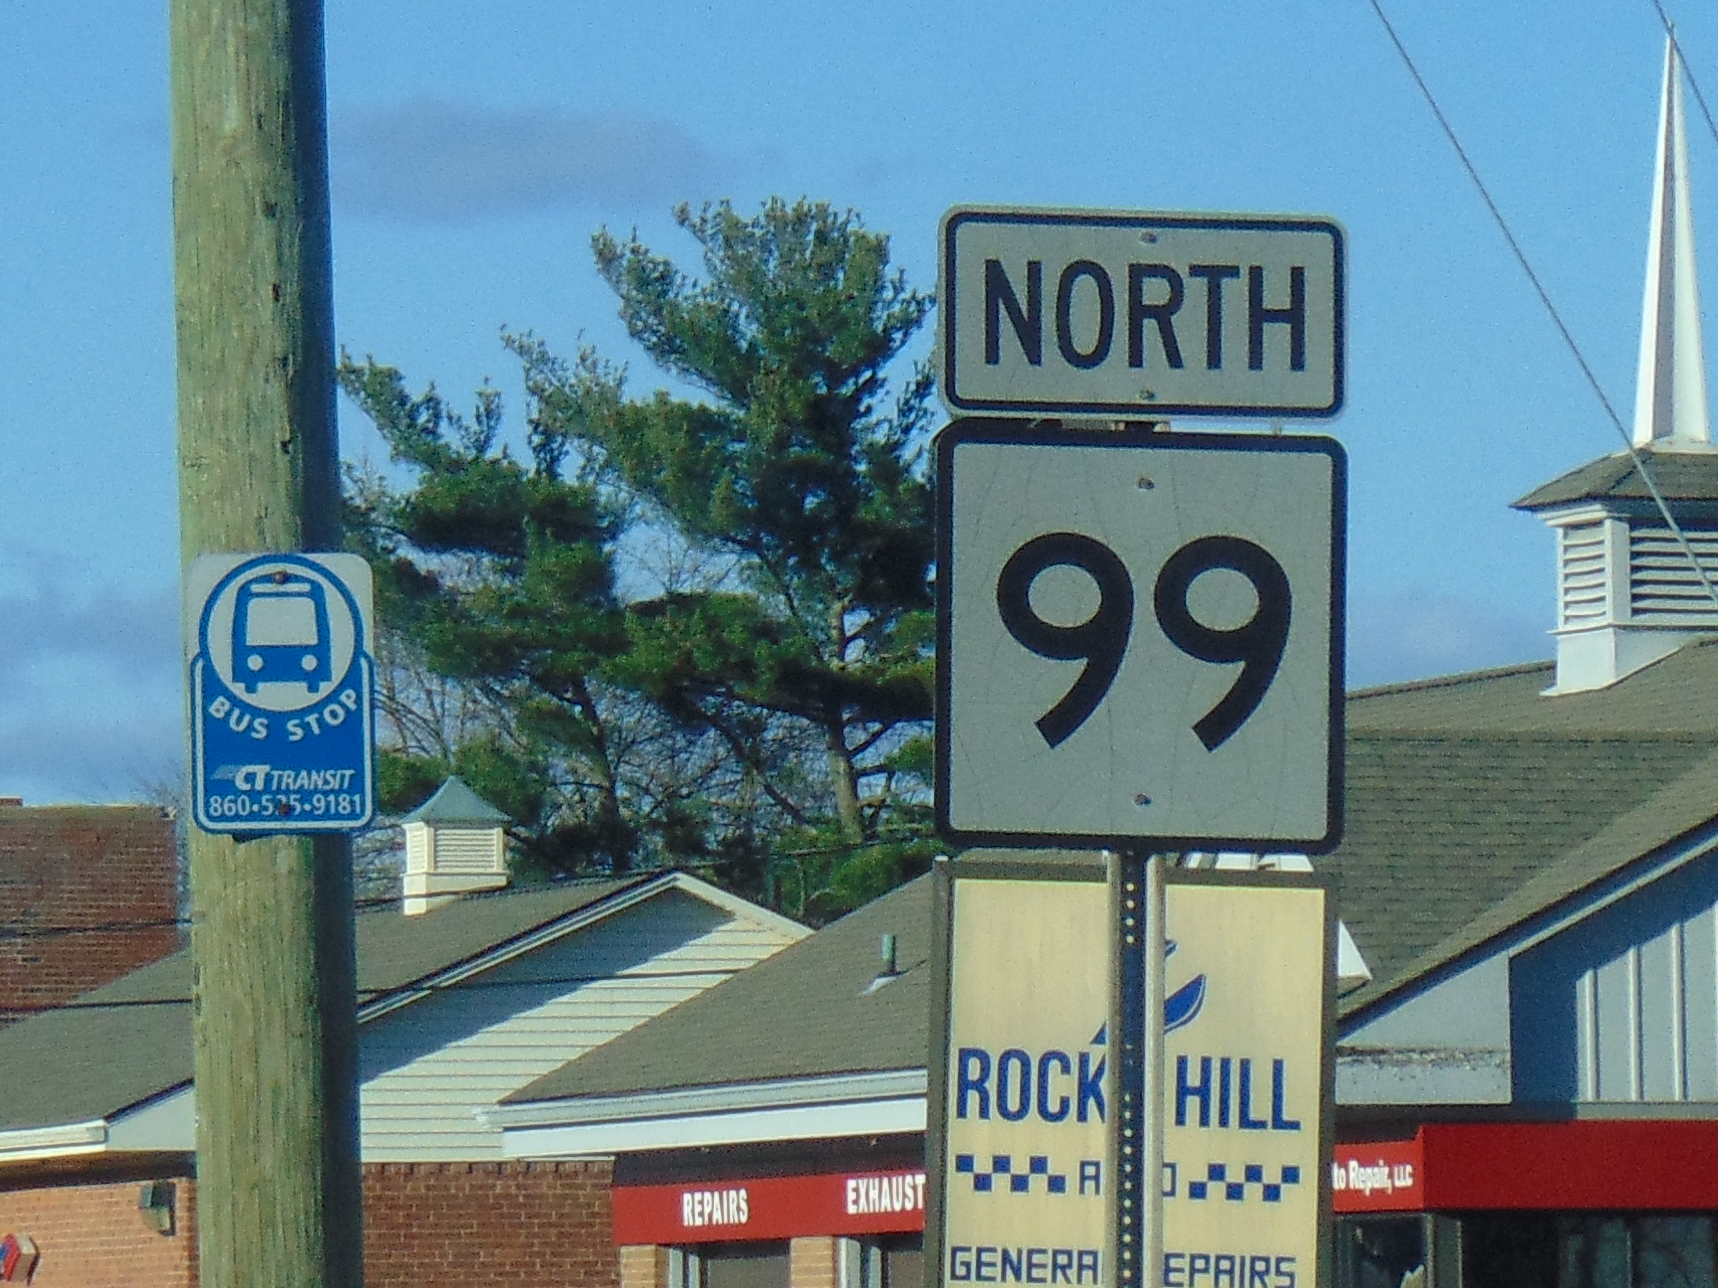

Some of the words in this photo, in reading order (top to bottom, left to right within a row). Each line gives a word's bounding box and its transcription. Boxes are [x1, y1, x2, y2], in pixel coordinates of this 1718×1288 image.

[984, 259, 1306, 372] NORTH
[996, 532, 1292, 752] 99
[208, 695, 269, 740] BUS
[286, 689, 358, 741] STOP
[955, 1046, 1107, 1124] ROCK
[1174, 1054, 1301, 1131] HILL
[682, 1188, 749, 1226] REPAIRS
[846, 1173, 927, 1215] EXHAUST
[950, 1246, 1103, 1286] GENERA
